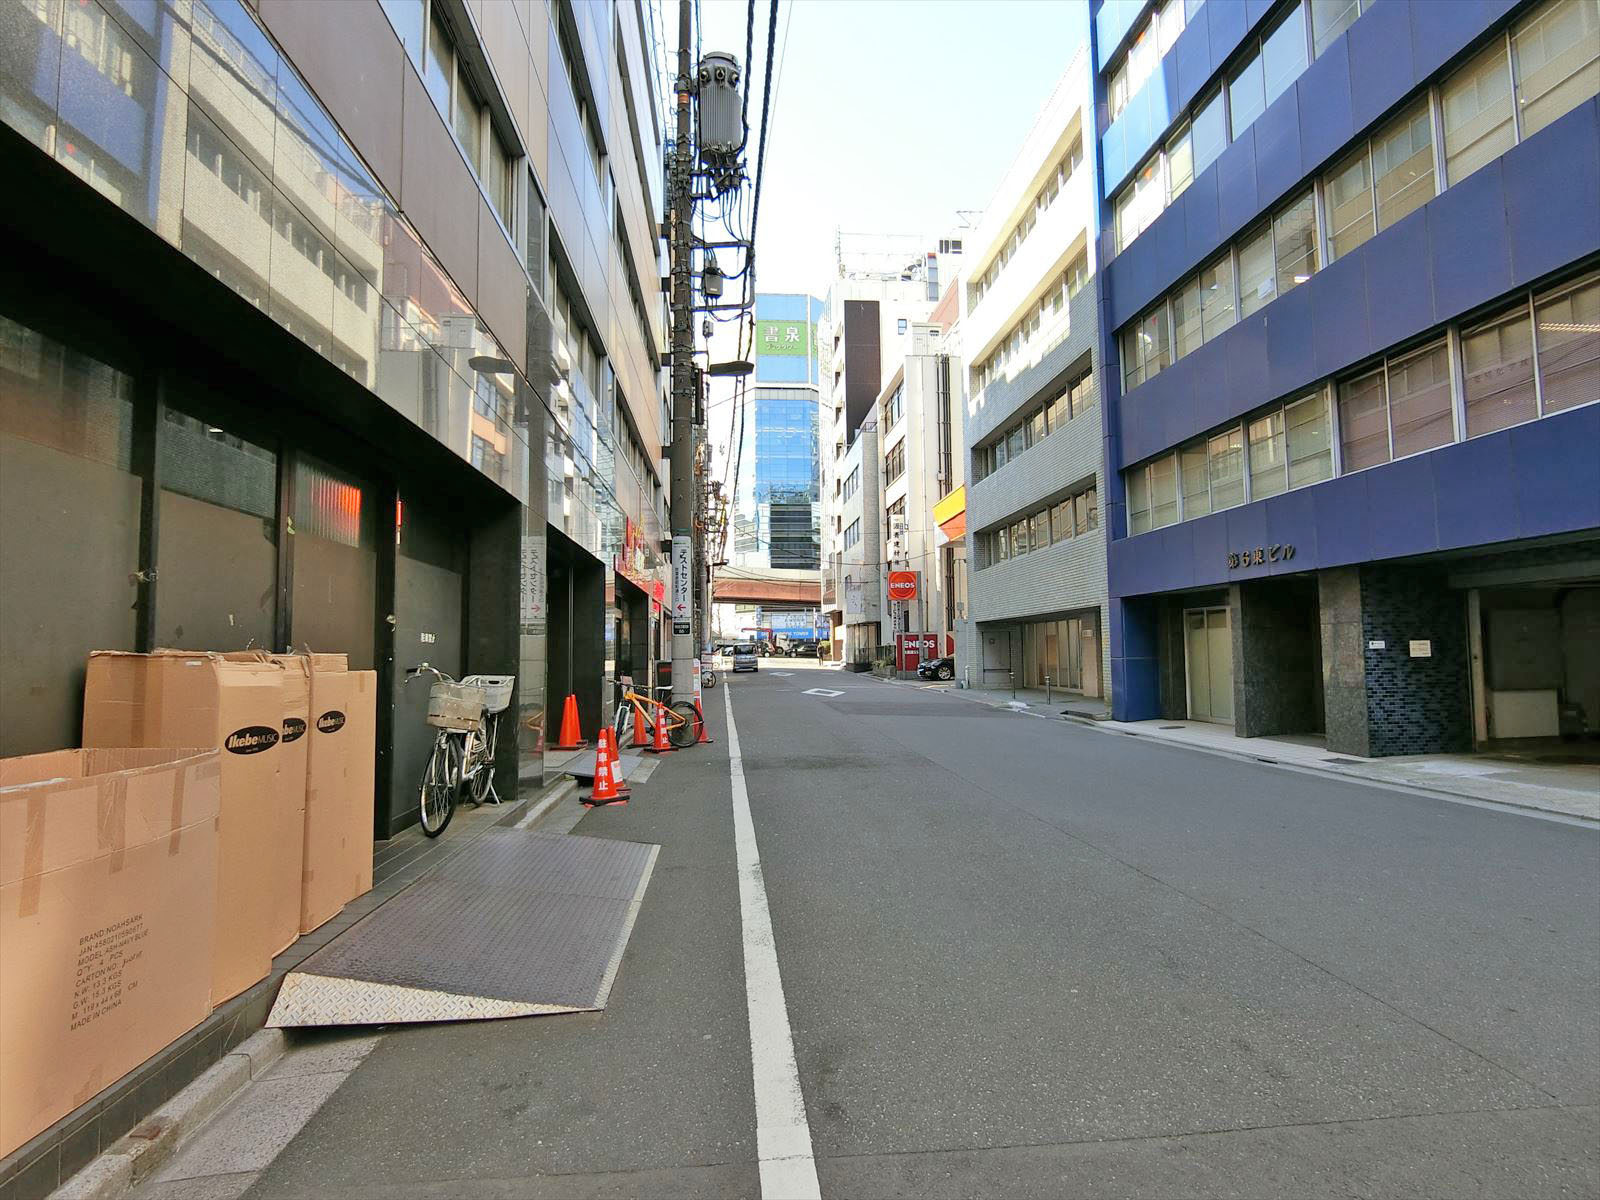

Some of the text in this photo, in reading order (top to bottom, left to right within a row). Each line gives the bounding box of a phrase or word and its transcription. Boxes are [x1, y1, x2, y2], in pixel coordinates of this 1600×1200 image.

[763, 326, 801, 342] 書泉
[680, 549, 688, 601] テストセンター
[904, 640, 935, 648] ENEOS
[70, 1014, 91, 1031] MADE
[101, 999, 122, 1015] CHINA
